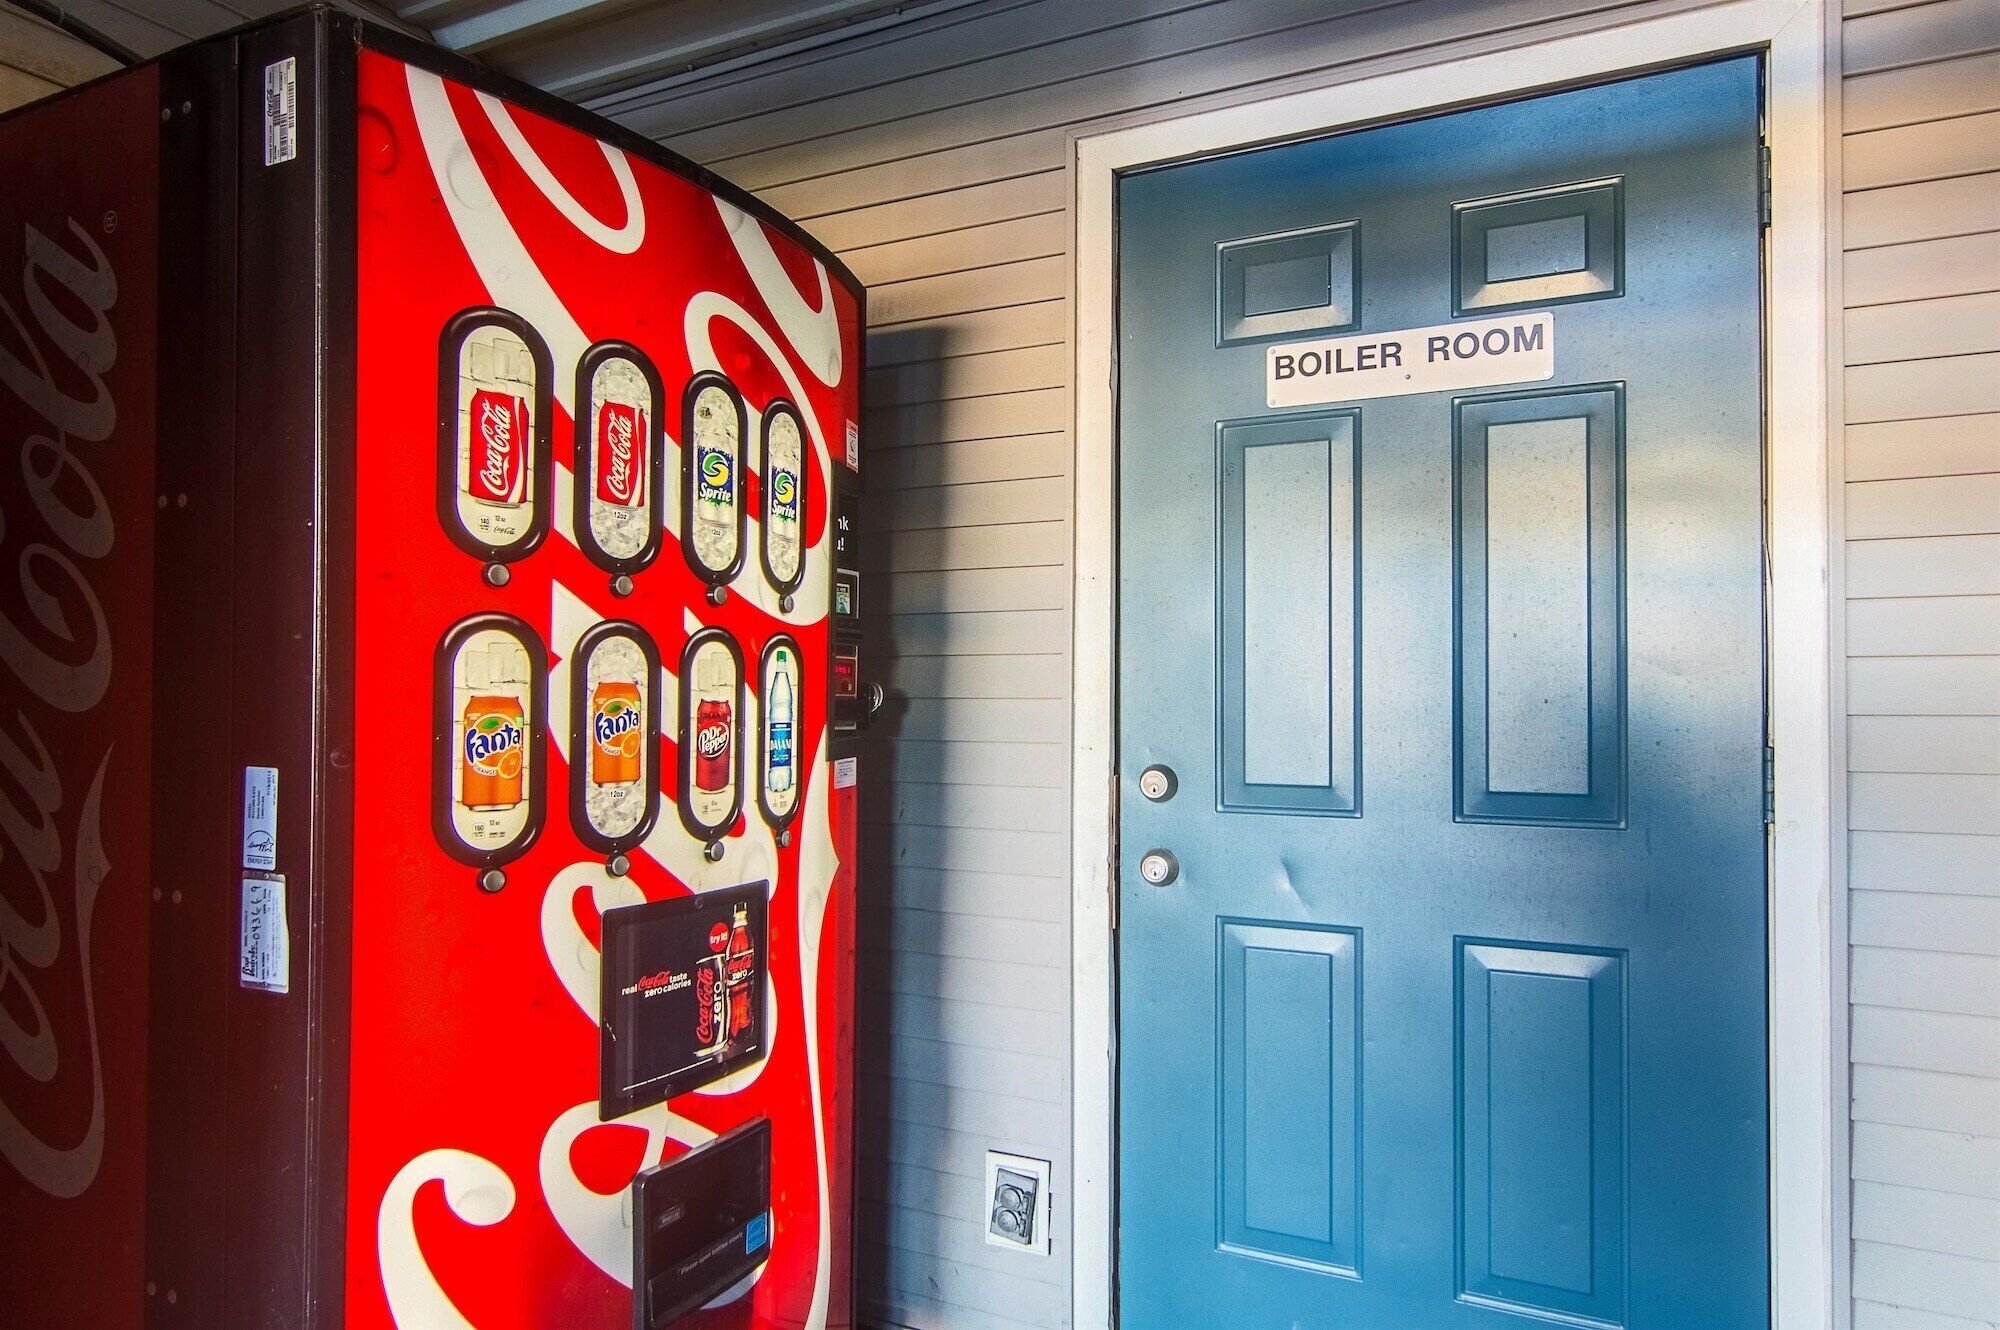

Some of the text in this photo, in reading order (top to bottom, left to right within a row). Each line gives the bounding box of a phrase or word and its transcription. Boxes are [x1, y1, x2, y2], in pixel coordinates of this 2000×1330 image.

[1275, 323, 1544, 380] BOILER ROOM
[700, 482, 732, 502] Sprite
[772, 500, 796, 518] Sprite
[595, 707, 639, 744] Fanta
[709, 726, 722, 741] Dr
[466, 723, 521, 764] Fanta
[701, 729, 728, 754] Pepper
[710, 934, 720, 944] try
[621, 984, 638, 996] real
[669, 972, 688, 984] taste
[732, 969, 747, 980] zero
[644, 979, 692, 998] zero calories
[714, 981, 722, 1024] zero
